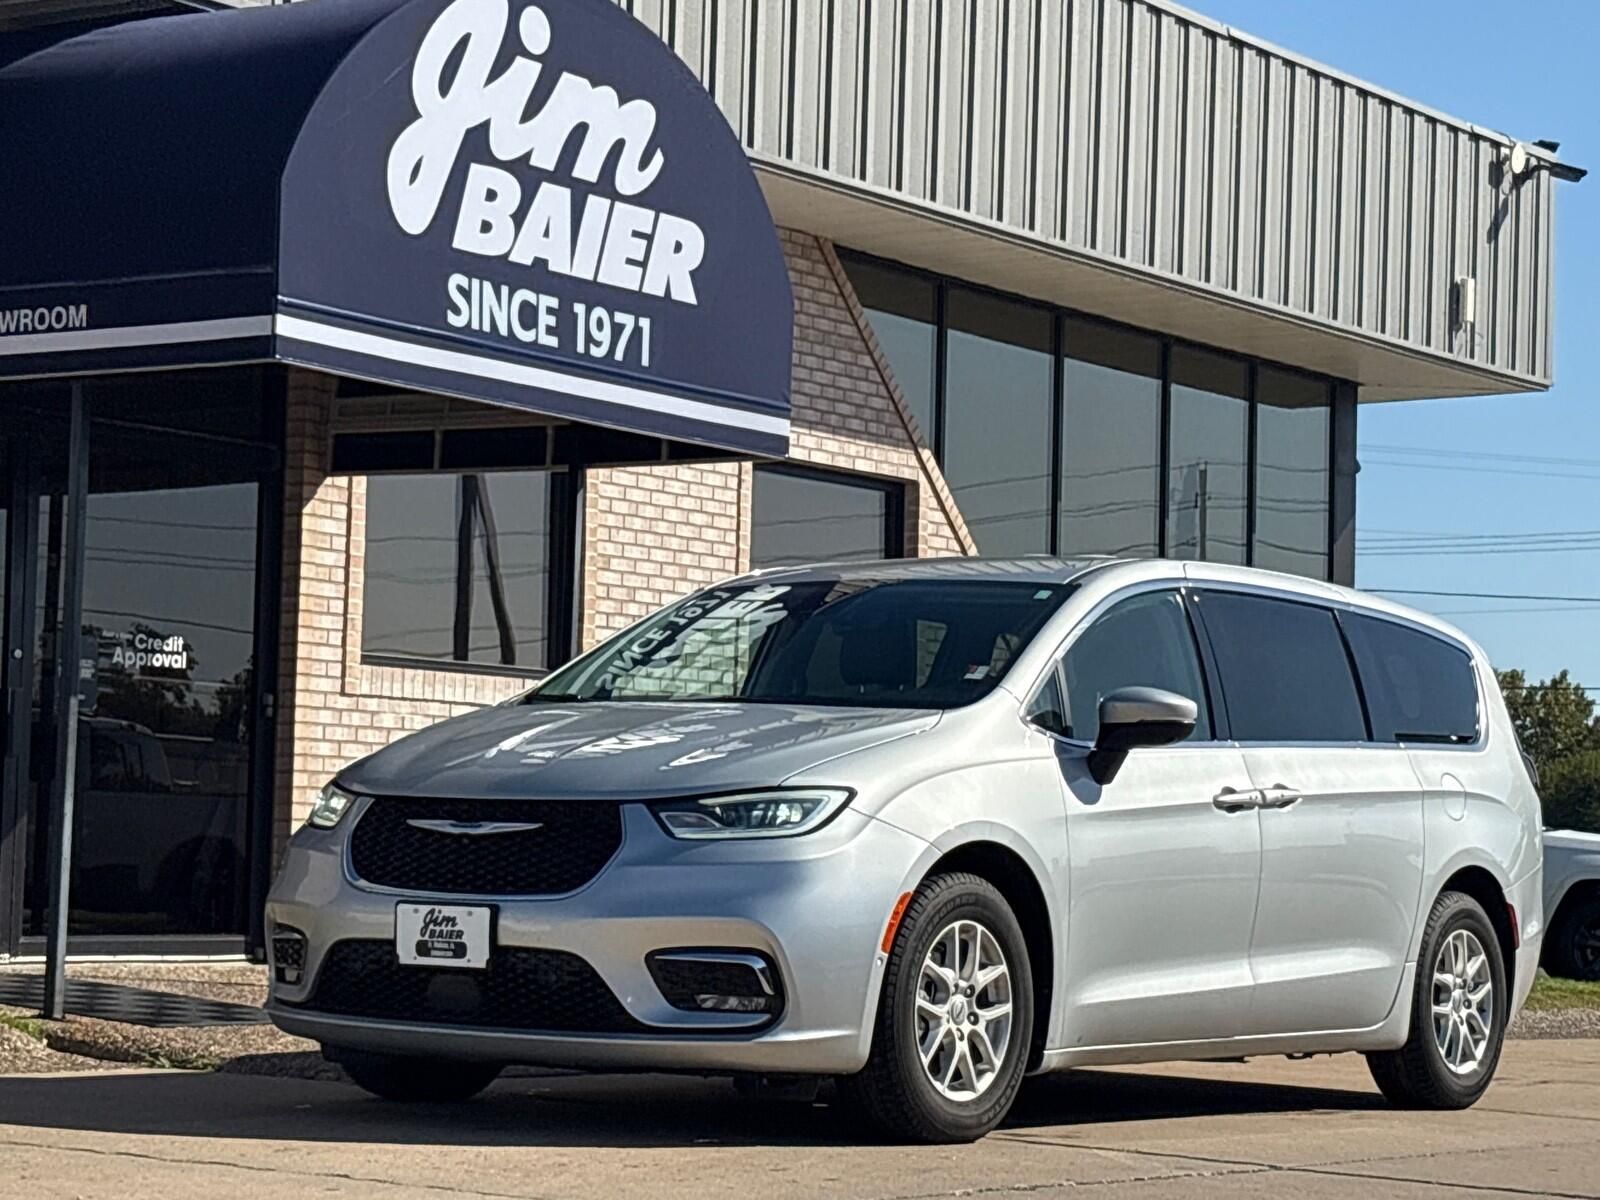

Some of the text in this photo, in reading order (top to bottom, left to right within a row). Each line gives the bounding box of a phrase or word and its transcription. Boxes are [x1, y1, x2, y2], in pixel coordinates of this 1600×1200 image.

[387, 0, 664, 235] Jim
[451, 162, 706, 305] BAIER
[446, 272, 652, 367] SINCE 1971
[112, 646, 188, 669] Approval
[134, 633, 184, 652] Credit
[420, 907, 458, 938] Jim
[428, 929, 465, 940] BAIER
